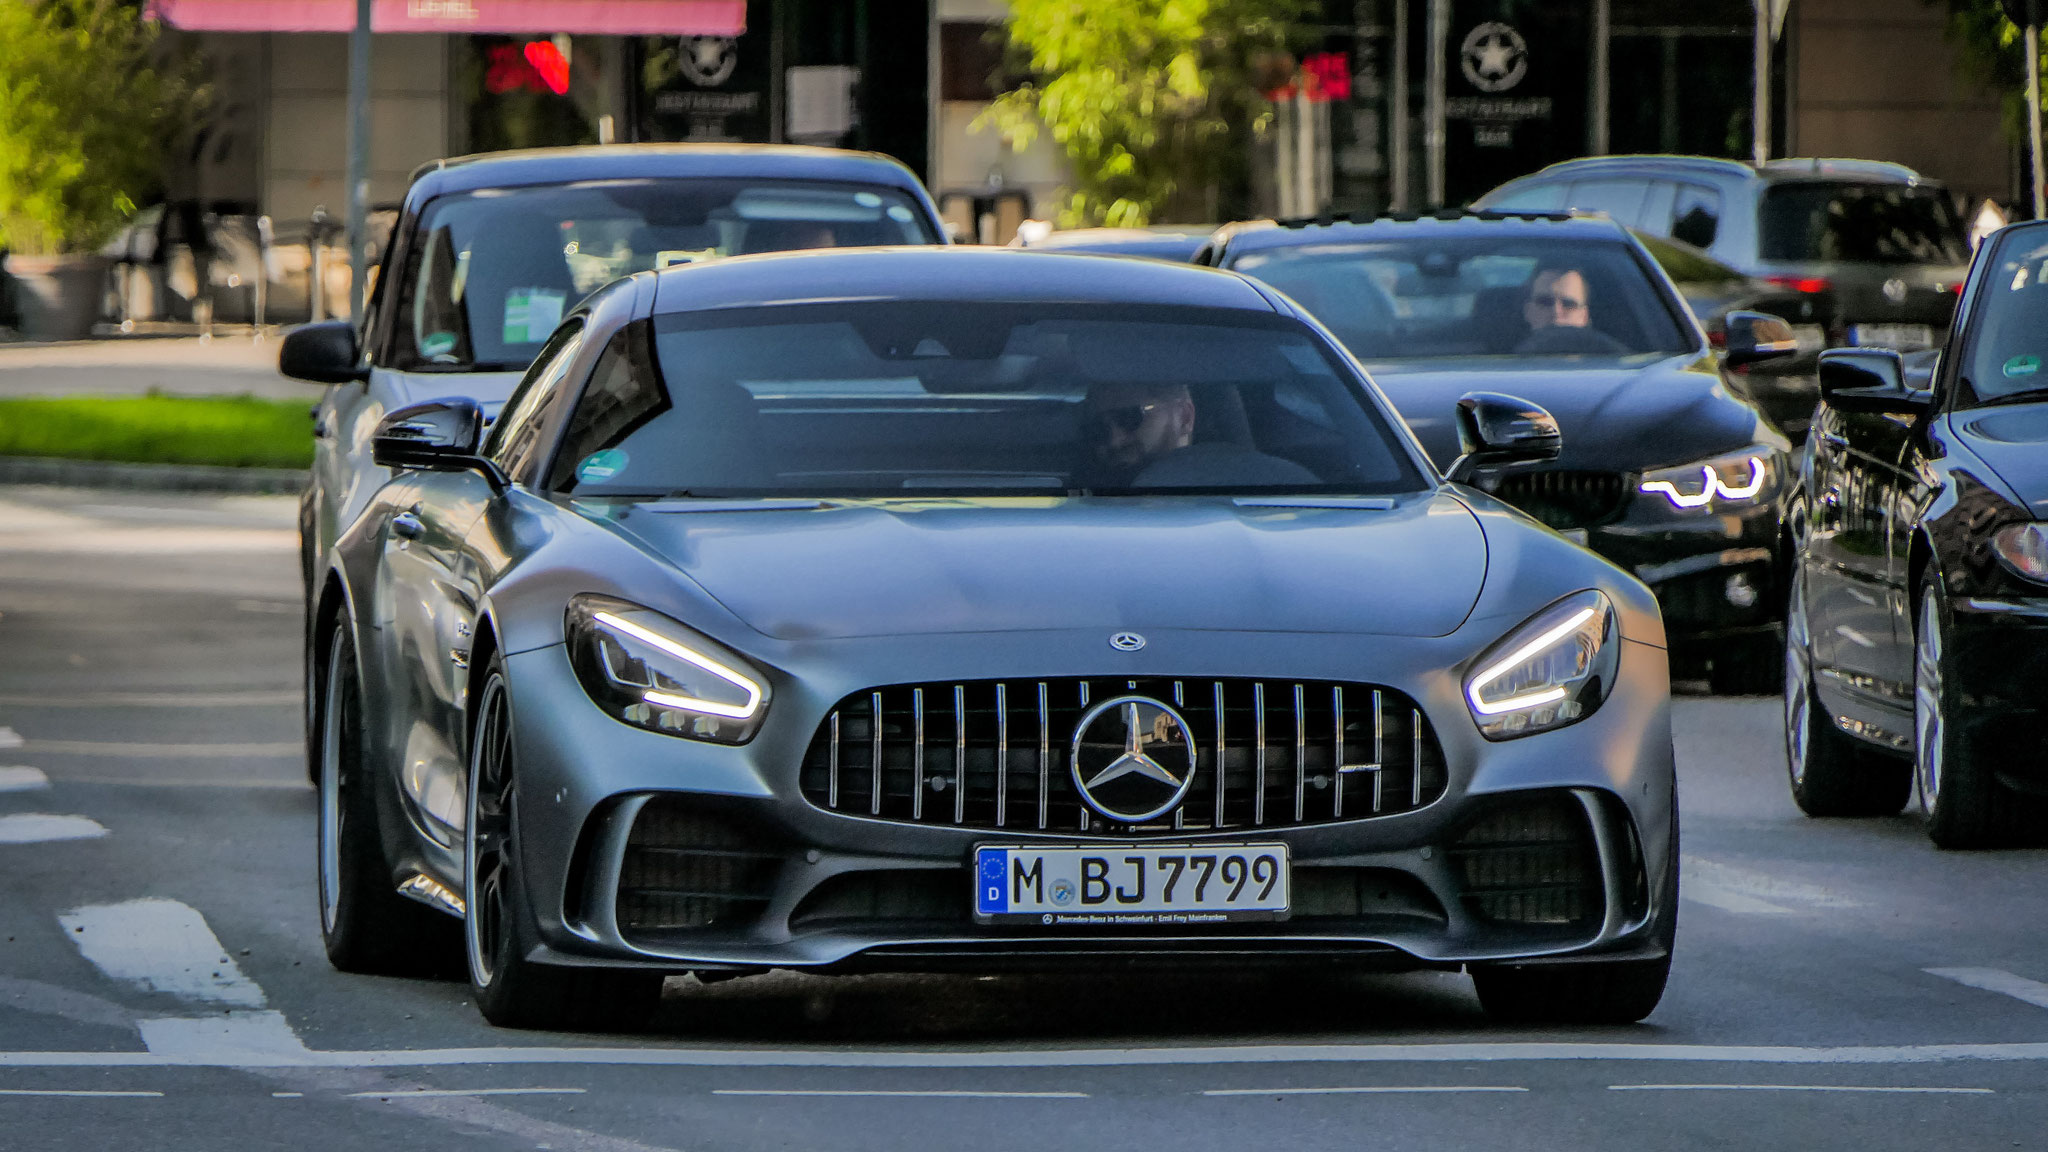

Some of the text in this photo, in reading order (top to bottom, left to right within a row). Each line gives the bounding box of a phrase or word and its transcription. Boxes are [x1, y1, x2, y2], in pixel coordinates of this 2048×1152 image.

[1013, 854, 1279, 904] M BJ 7799
[988, 887, 999, 900] D
[1174, 914, 1187, 923] Frey
